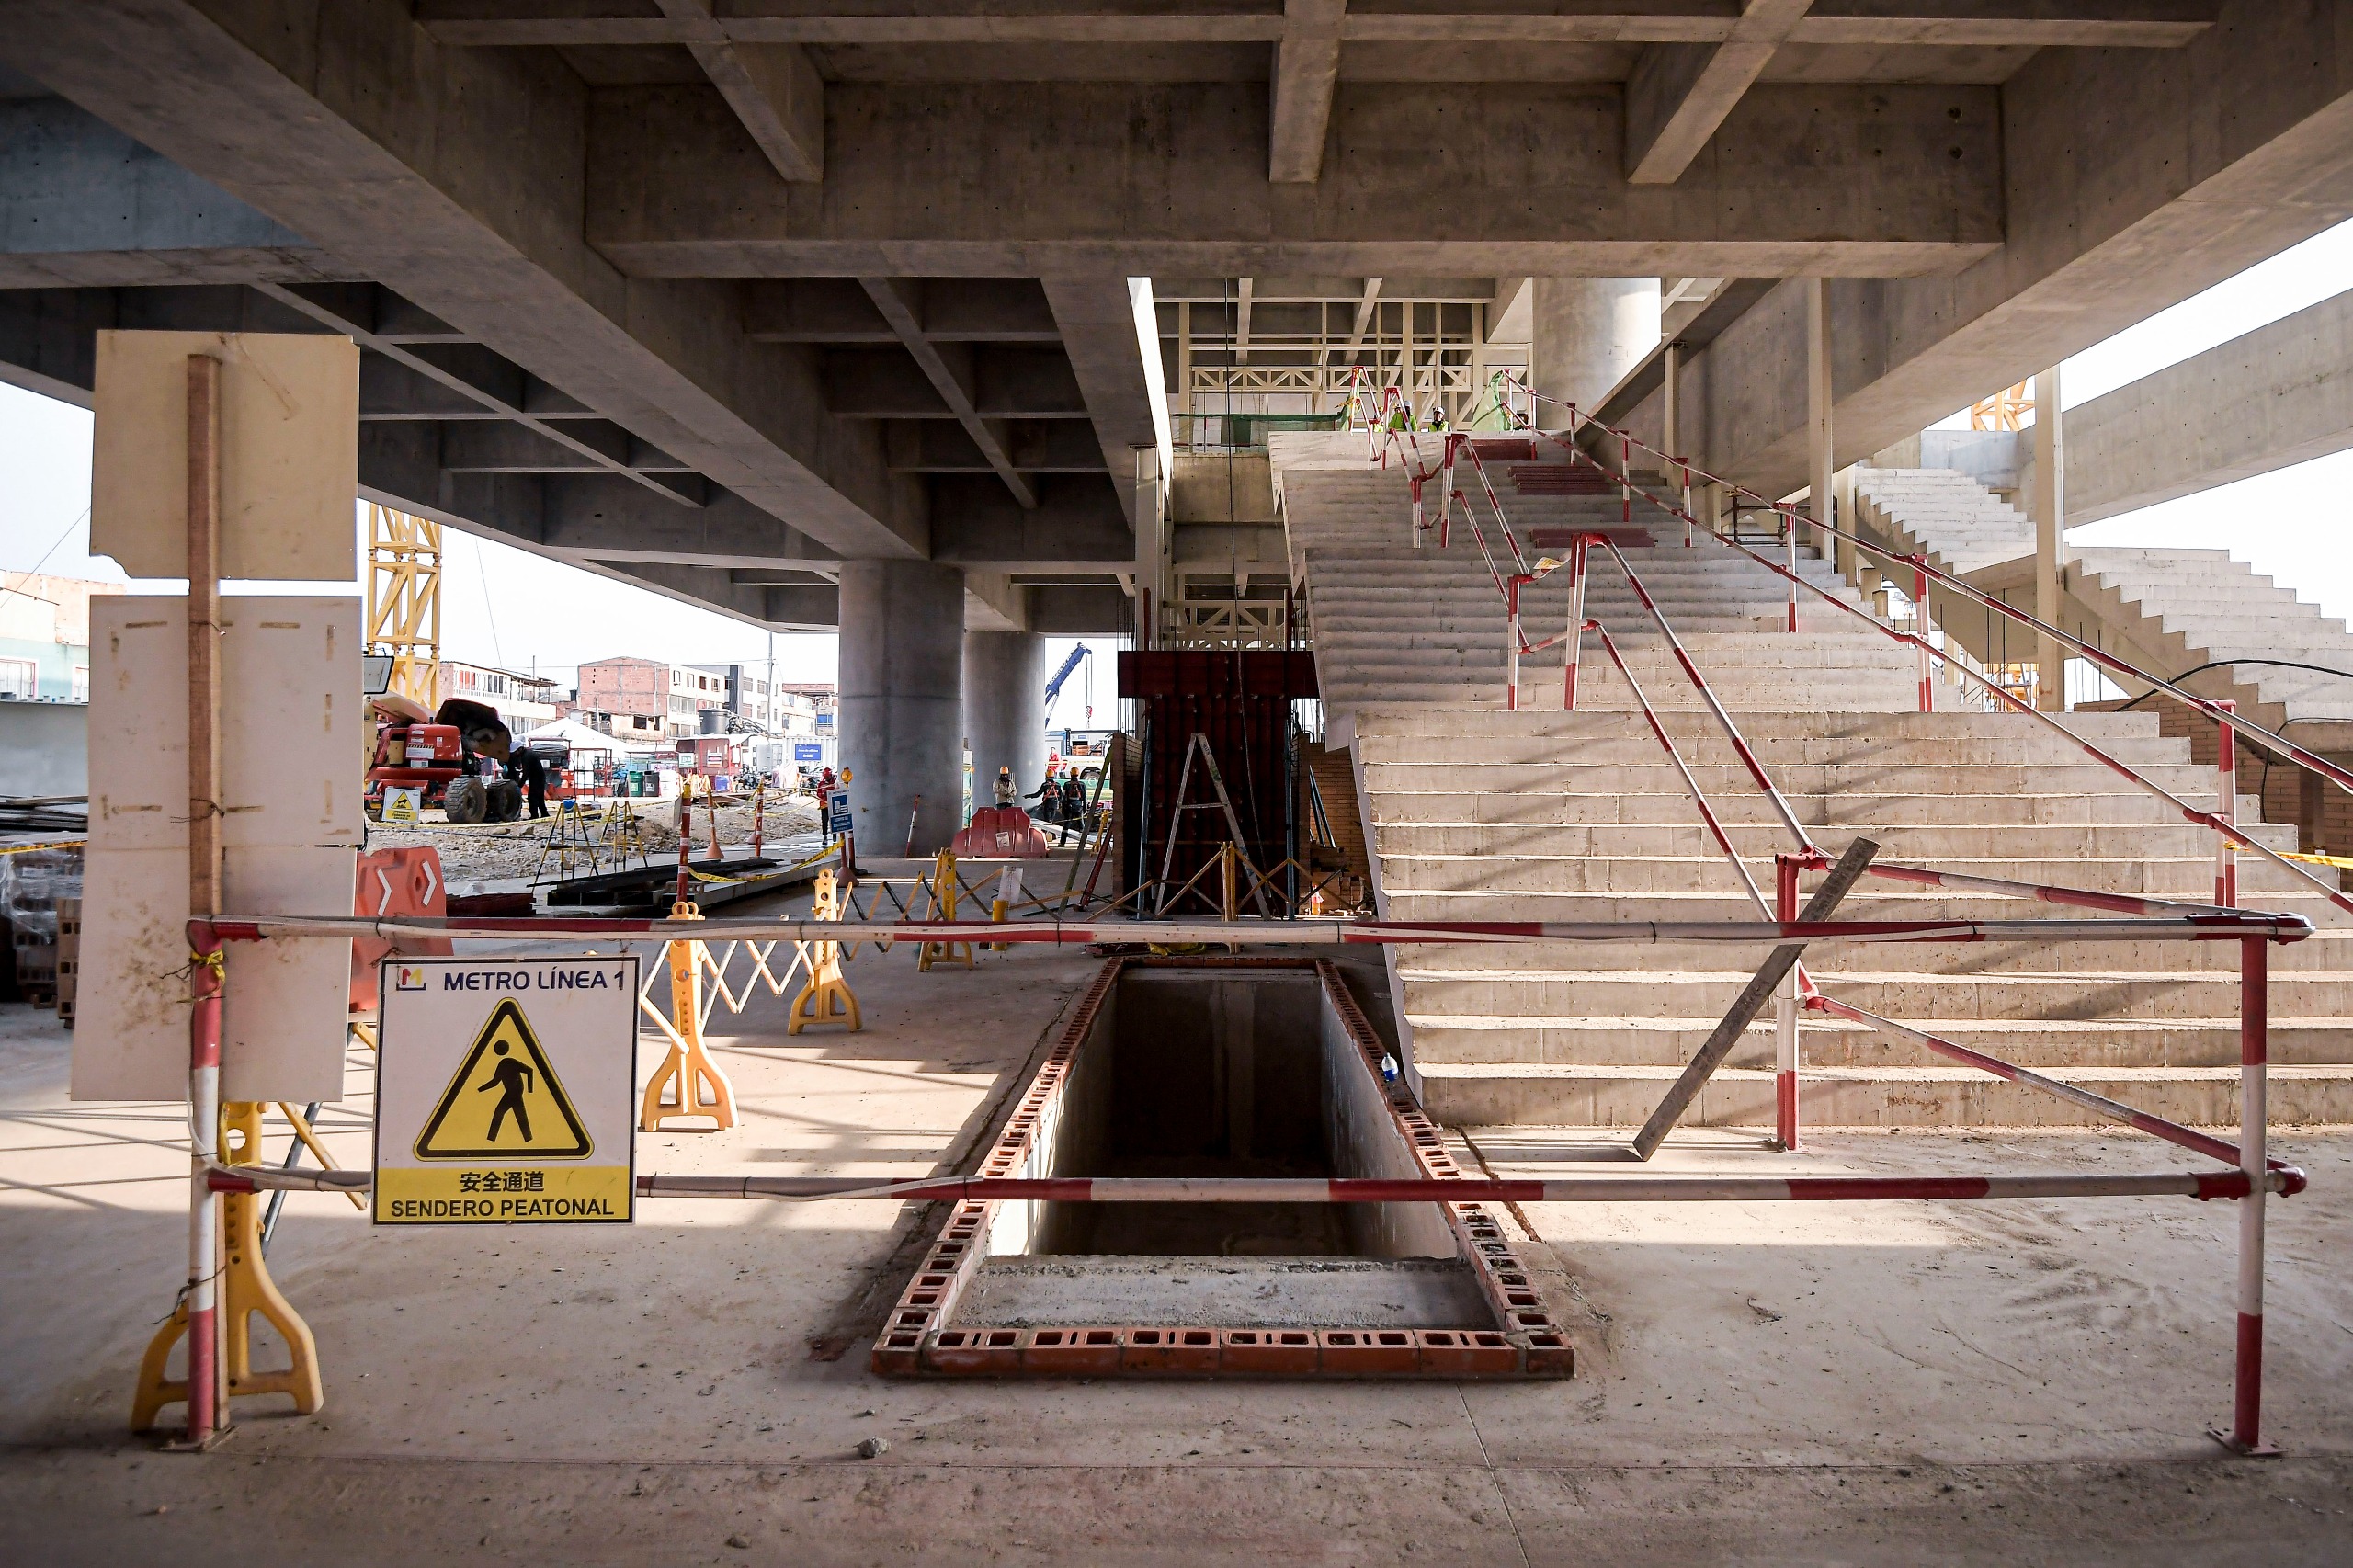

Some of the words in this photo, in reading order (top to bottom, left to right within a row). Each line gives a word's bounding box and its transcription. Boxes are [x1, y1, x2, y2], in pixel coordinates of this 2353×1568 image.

[443, 971, 530, 991] METRO
[537, 966, 608, 990] LÍNEA
[614, 970, 624, 990] 1
[460, 1171, 545, 1193] 安全通道
[391, 1199, 494, 1218] SENDERO
[501, 1199, 615, 1216] PEATONAL
